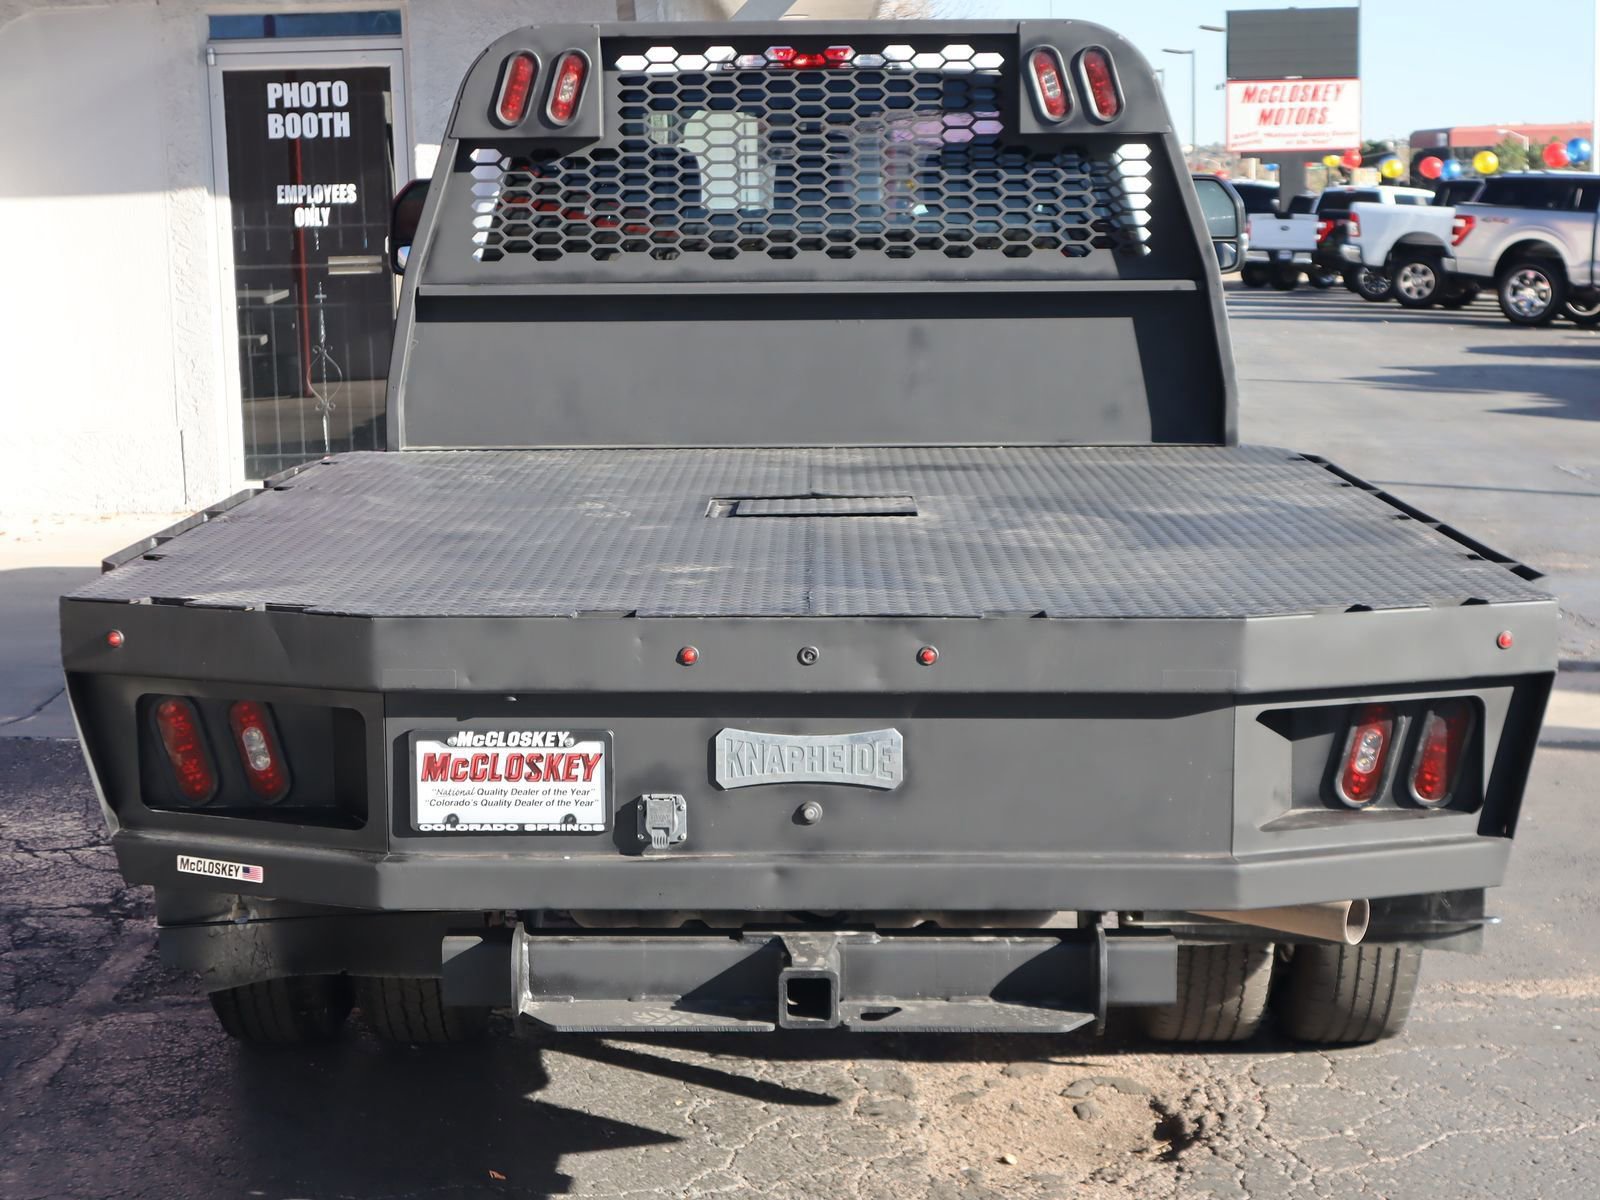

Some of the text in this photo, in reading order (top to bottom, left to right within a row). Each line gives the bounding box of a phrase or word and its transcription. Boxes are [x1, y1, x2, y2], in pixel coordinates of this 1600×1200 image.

[267, 80, 349, 109] PHOTO
[1242, 84, 1344, 103] McCLOSKEY
[267, 112, 351, 139] BOOTH
[1258, 107, 1329, 126] MOTORS
[276, 184, 357, 204] EMPLOYEES
[294, 207, 331, 227] ONLY
[456, 731, 570, 748] McCLOSKEY
[420, 752, 603, 782] McCLOSKEY
[724, 738, 894, 780] KNAPHEIDE
[476, 787, 509, 797] Quality
[510, 787, 540, 796] Dealer
[541, 787, 552, 796] of
[553, 787, 568, 796] the
[480, 798, 513, 808] Quality
[514, 798, 543, 807] Dealer
[545, 798, 556, 807] of
[557, 798, 572, 807] the
[419, 823, 605, 832] COLORADO SPRINGS
[179, 857, 240, 877] McCLOSKEY
